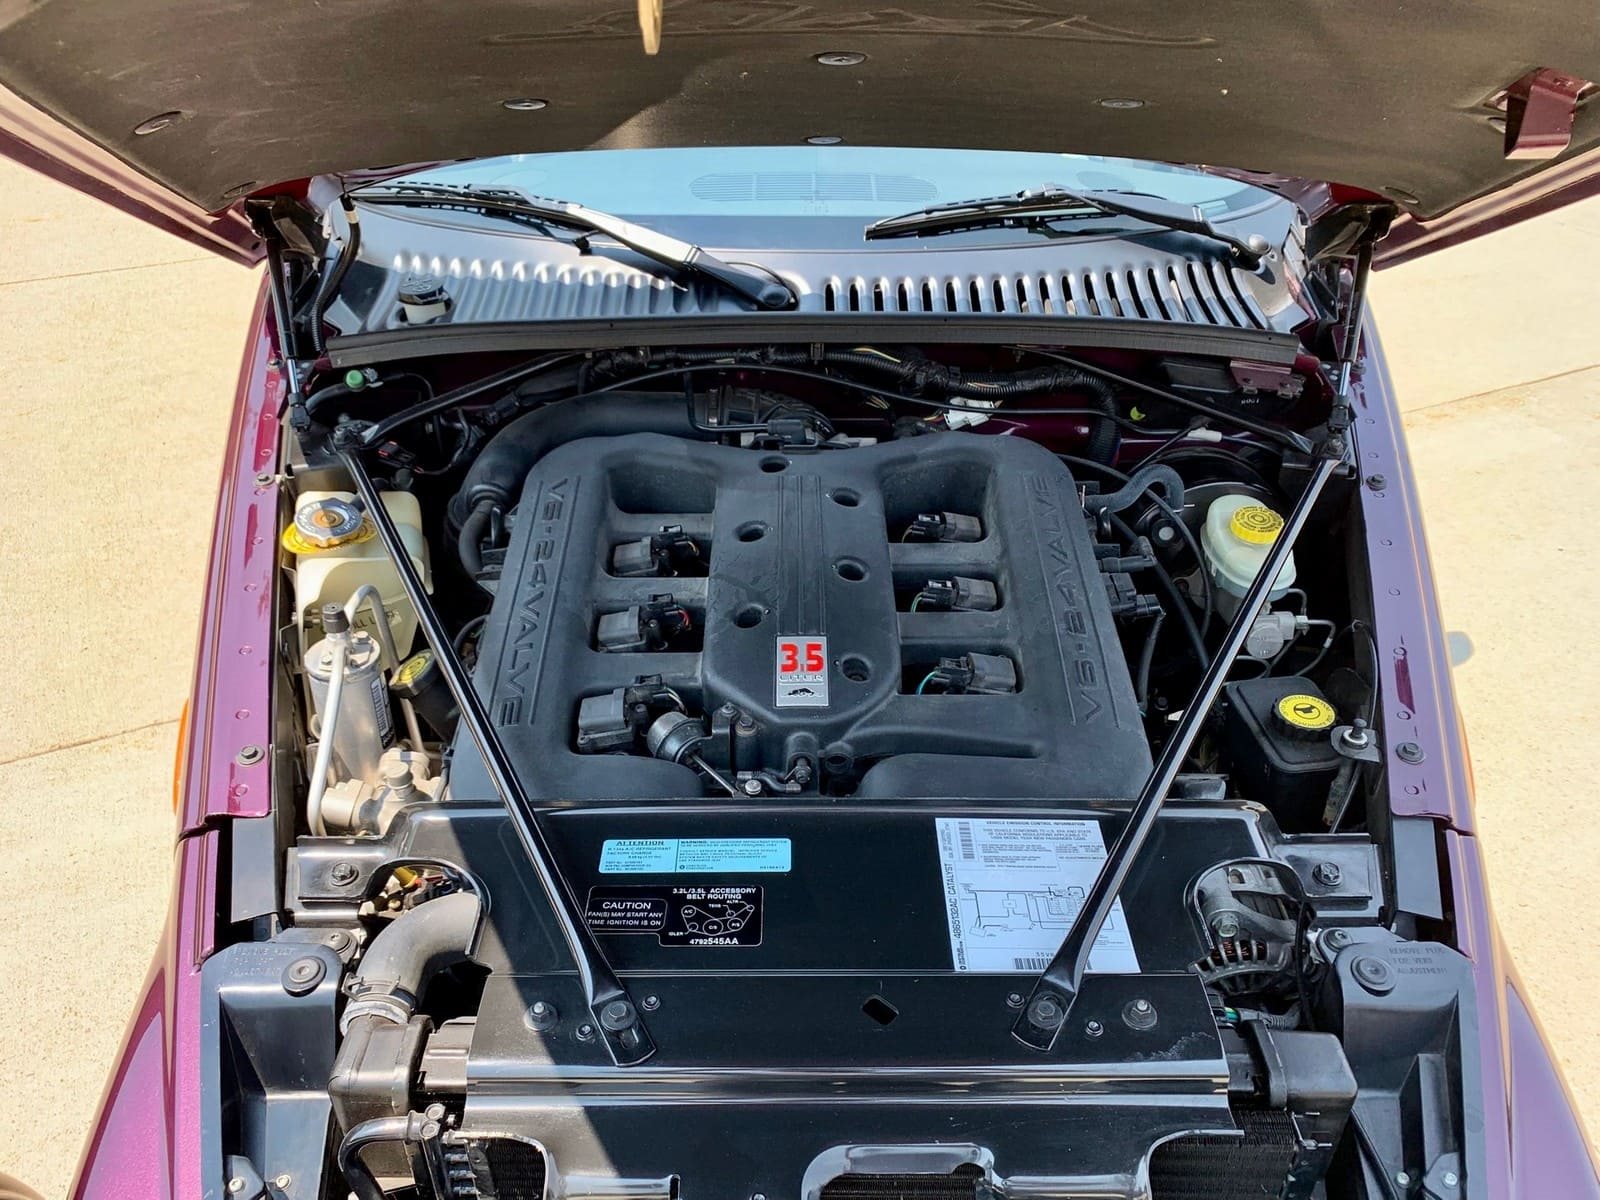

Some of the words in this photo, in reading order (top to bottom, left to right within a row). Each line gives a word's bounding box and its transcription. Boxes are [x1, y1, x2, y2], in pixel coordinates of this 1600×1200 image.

[780, 642, 824, 673] 3.5
[945, 863, 956, 895] CATALYST
[602, 901, 652, 910] CAUTION
